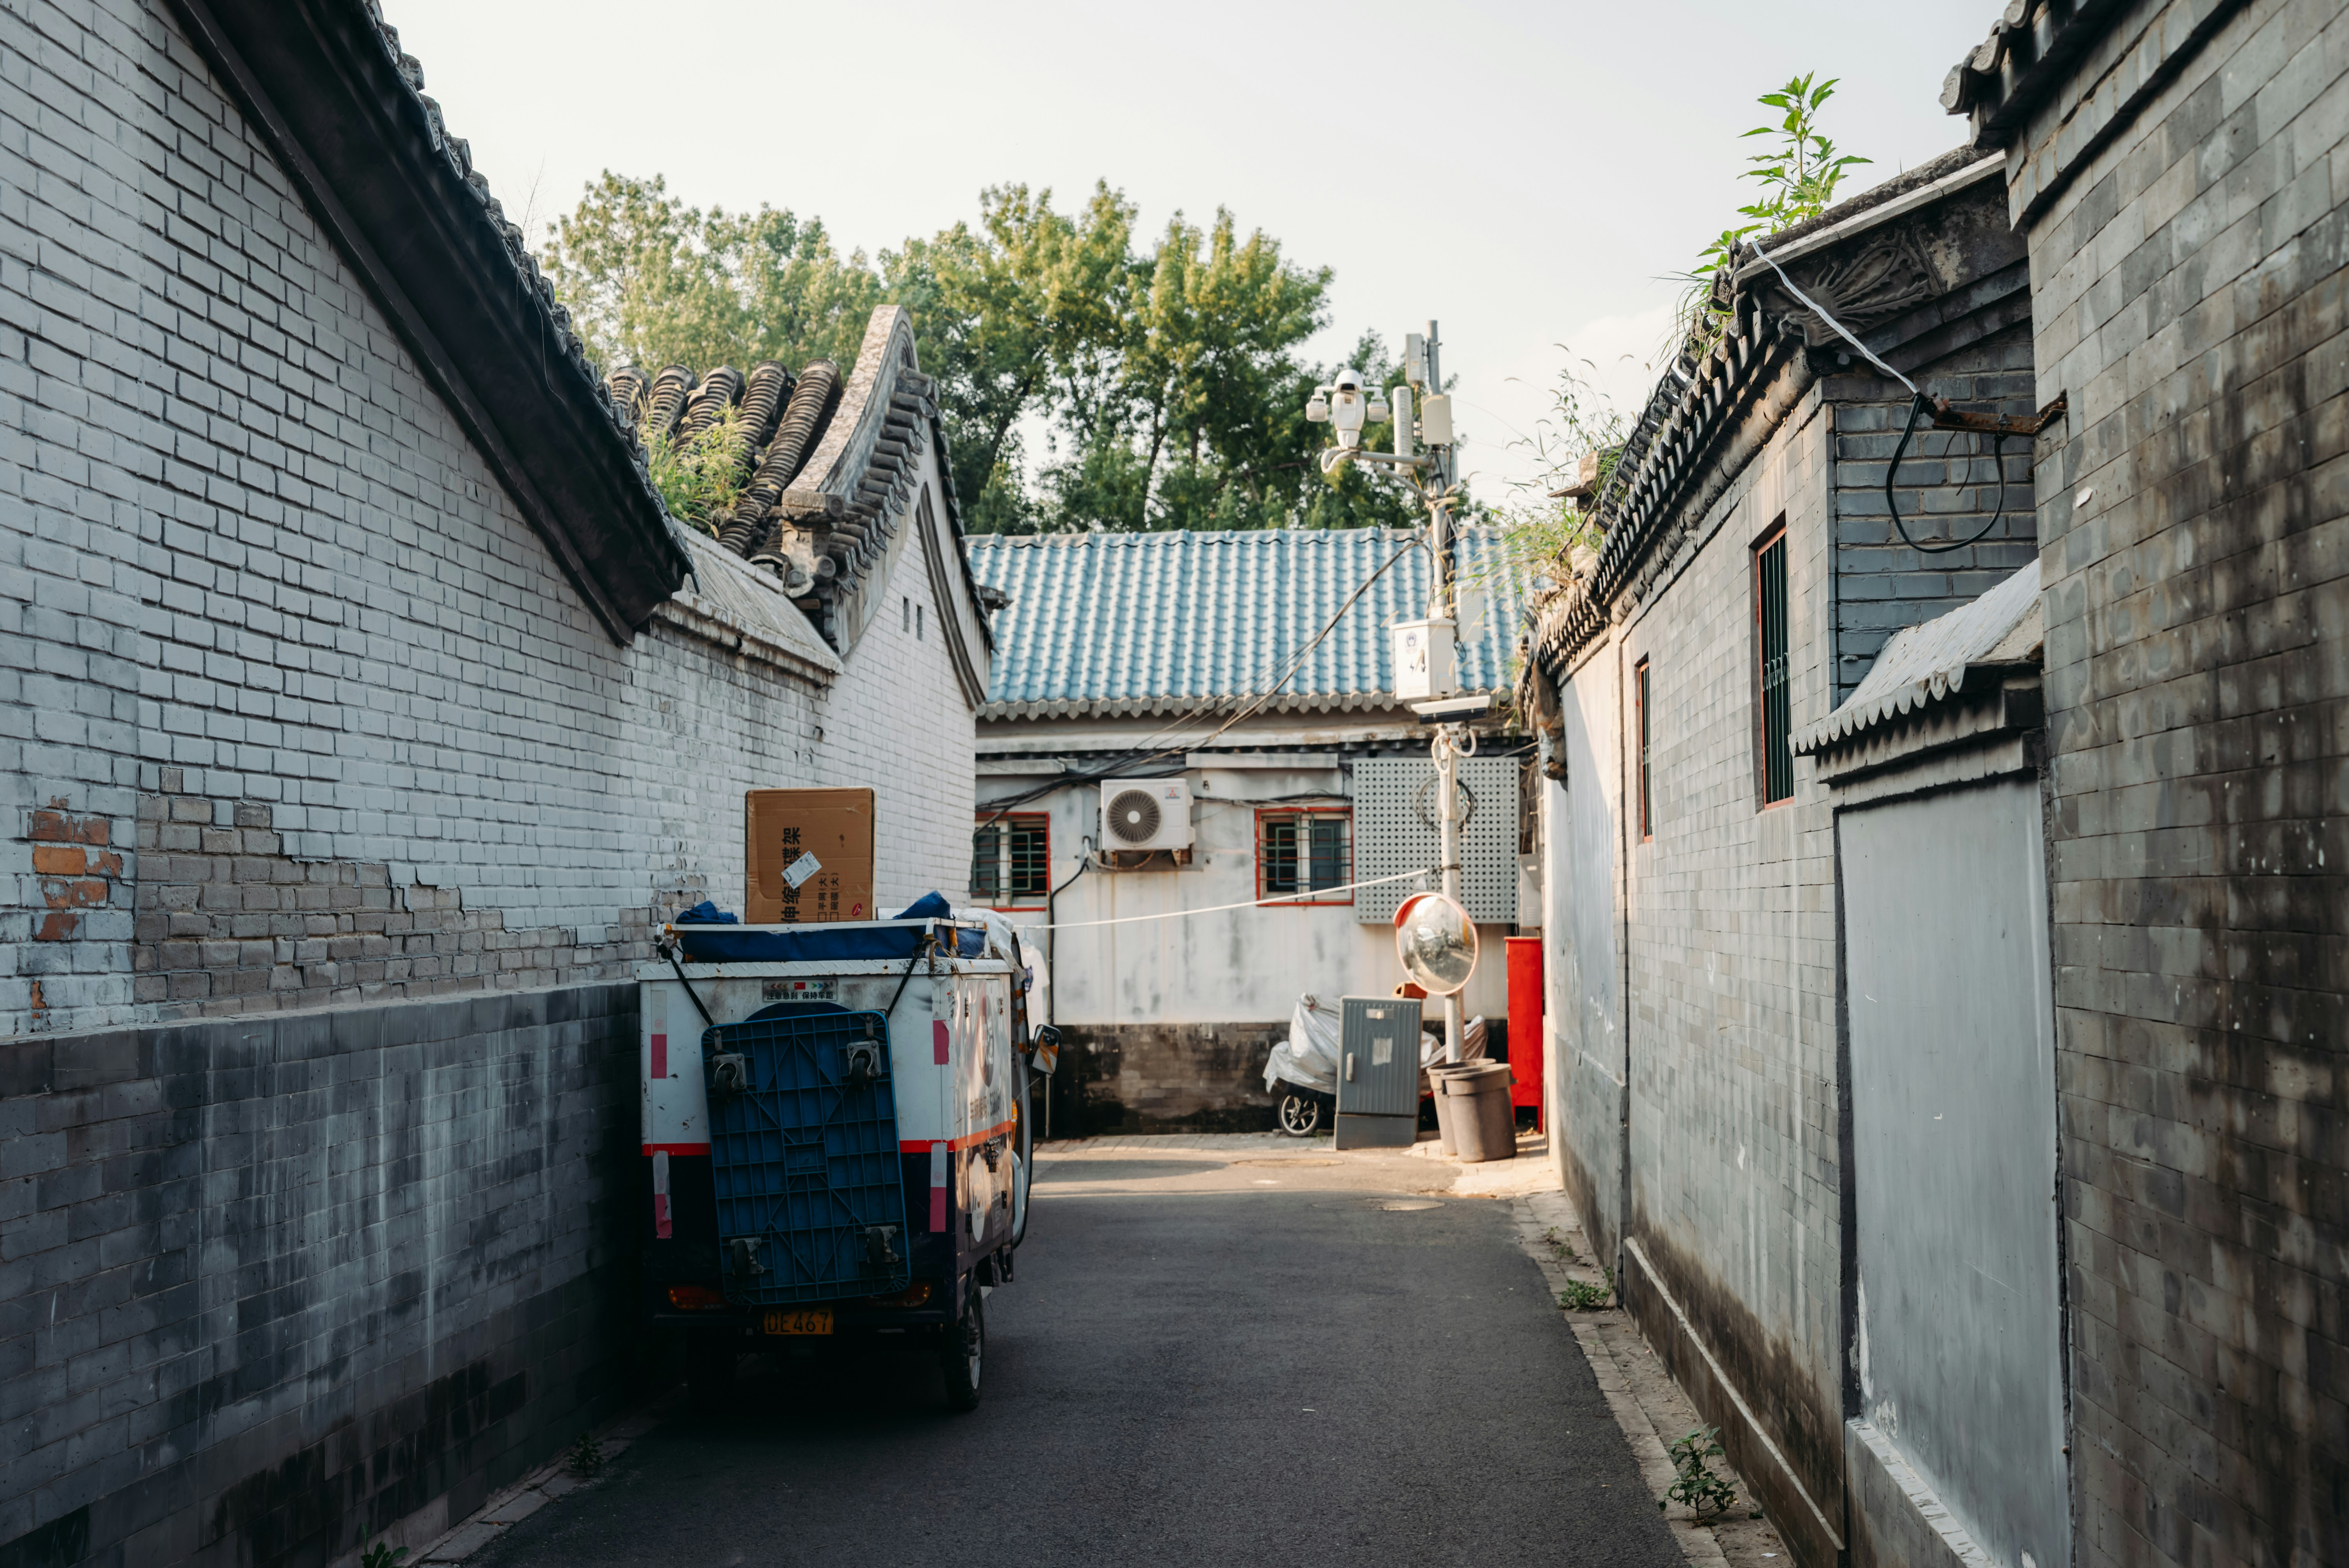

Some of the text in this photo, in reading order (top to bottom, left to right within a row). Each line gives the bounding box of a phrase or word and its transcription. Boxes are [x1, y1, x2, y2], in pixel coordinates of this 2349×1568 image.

[781, 827, 801, 922] 伸缩碟架
[766, 991, 834, 1000] 注意急刹 保持车距
[768, 1311, 829, 1332] DE467
